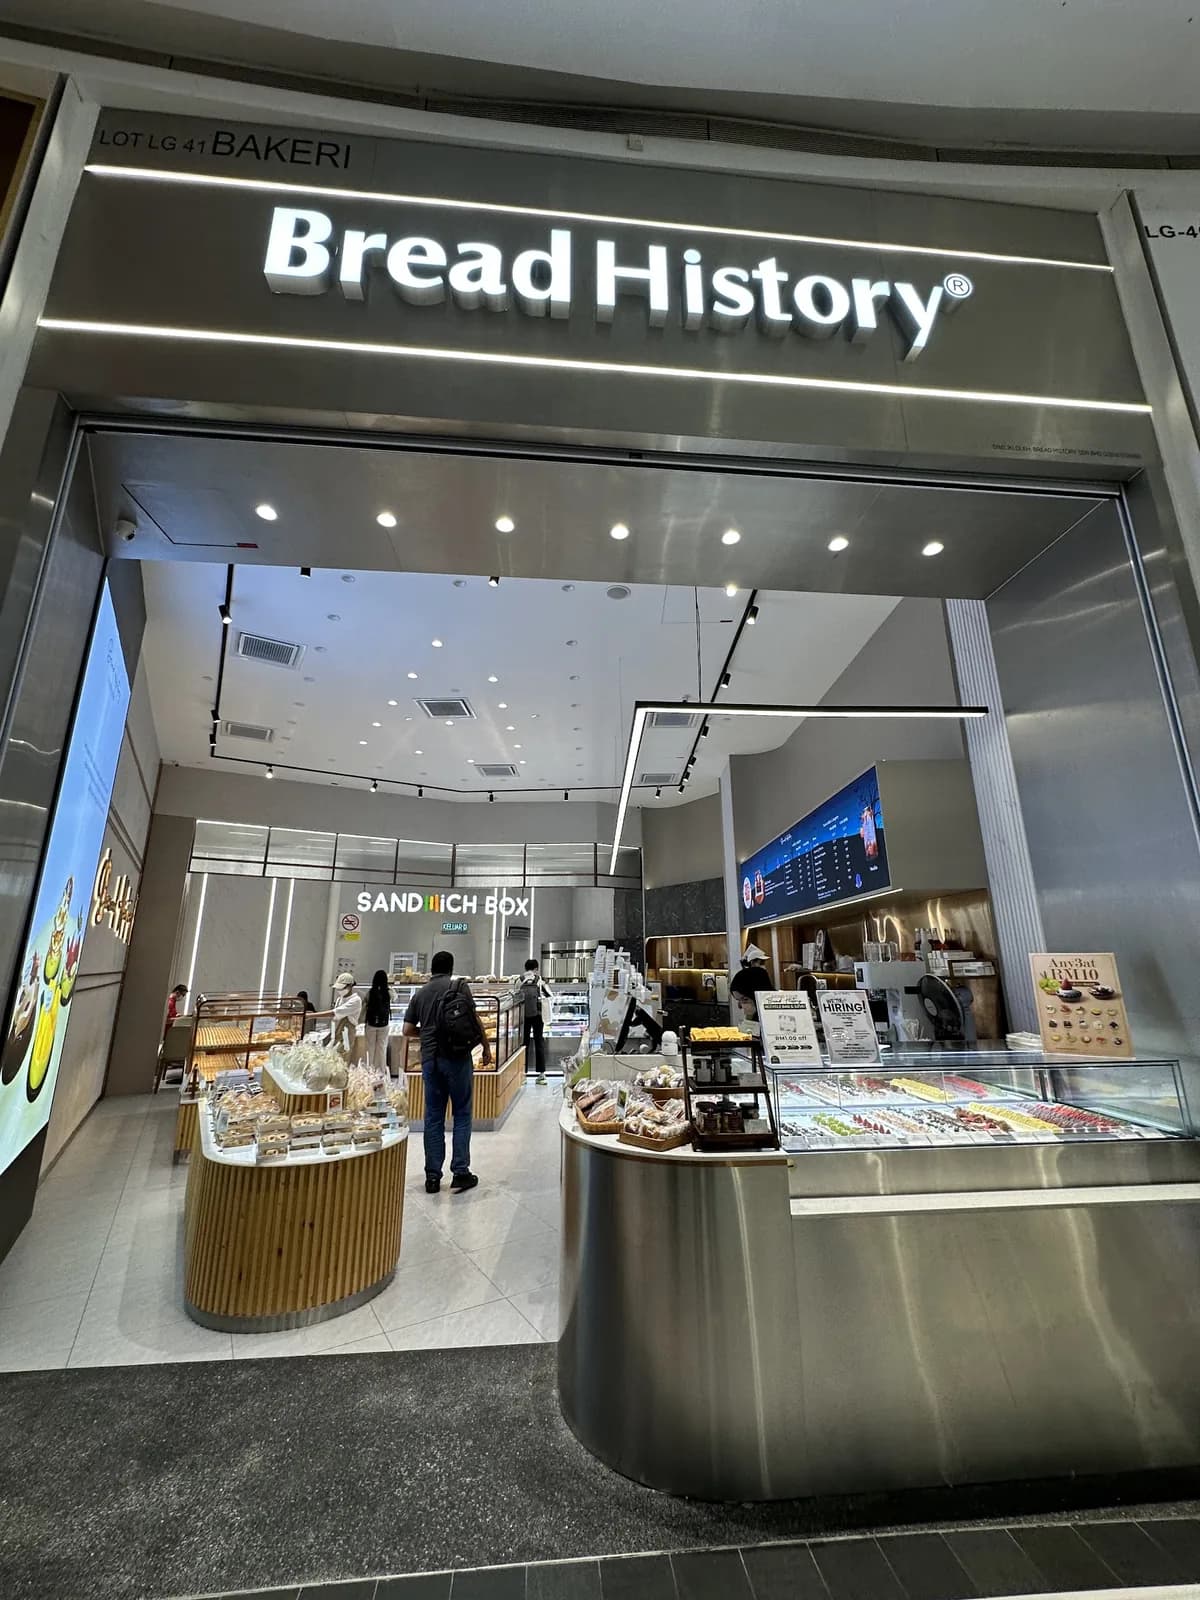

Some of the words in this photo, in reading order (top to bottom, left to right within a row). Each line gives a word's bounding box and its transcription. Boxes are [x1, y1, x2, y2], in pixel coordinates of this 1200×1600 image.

[99, 130, 144, 148] LOT
[147, 134, 177, 151] LG
[182, 138, 206, 154] 41
[211, 131, 351, 169] BAKERI
[1144, 225, 1200, 238] LG-4
[264, 207, 572, 315] Bread
[595, 240, 943, 358] History
[485, 896, 529, 917] BOX
[1051, 968, 1099, 980] RM10
[822, 1000, 867, 1014] HIRING!
